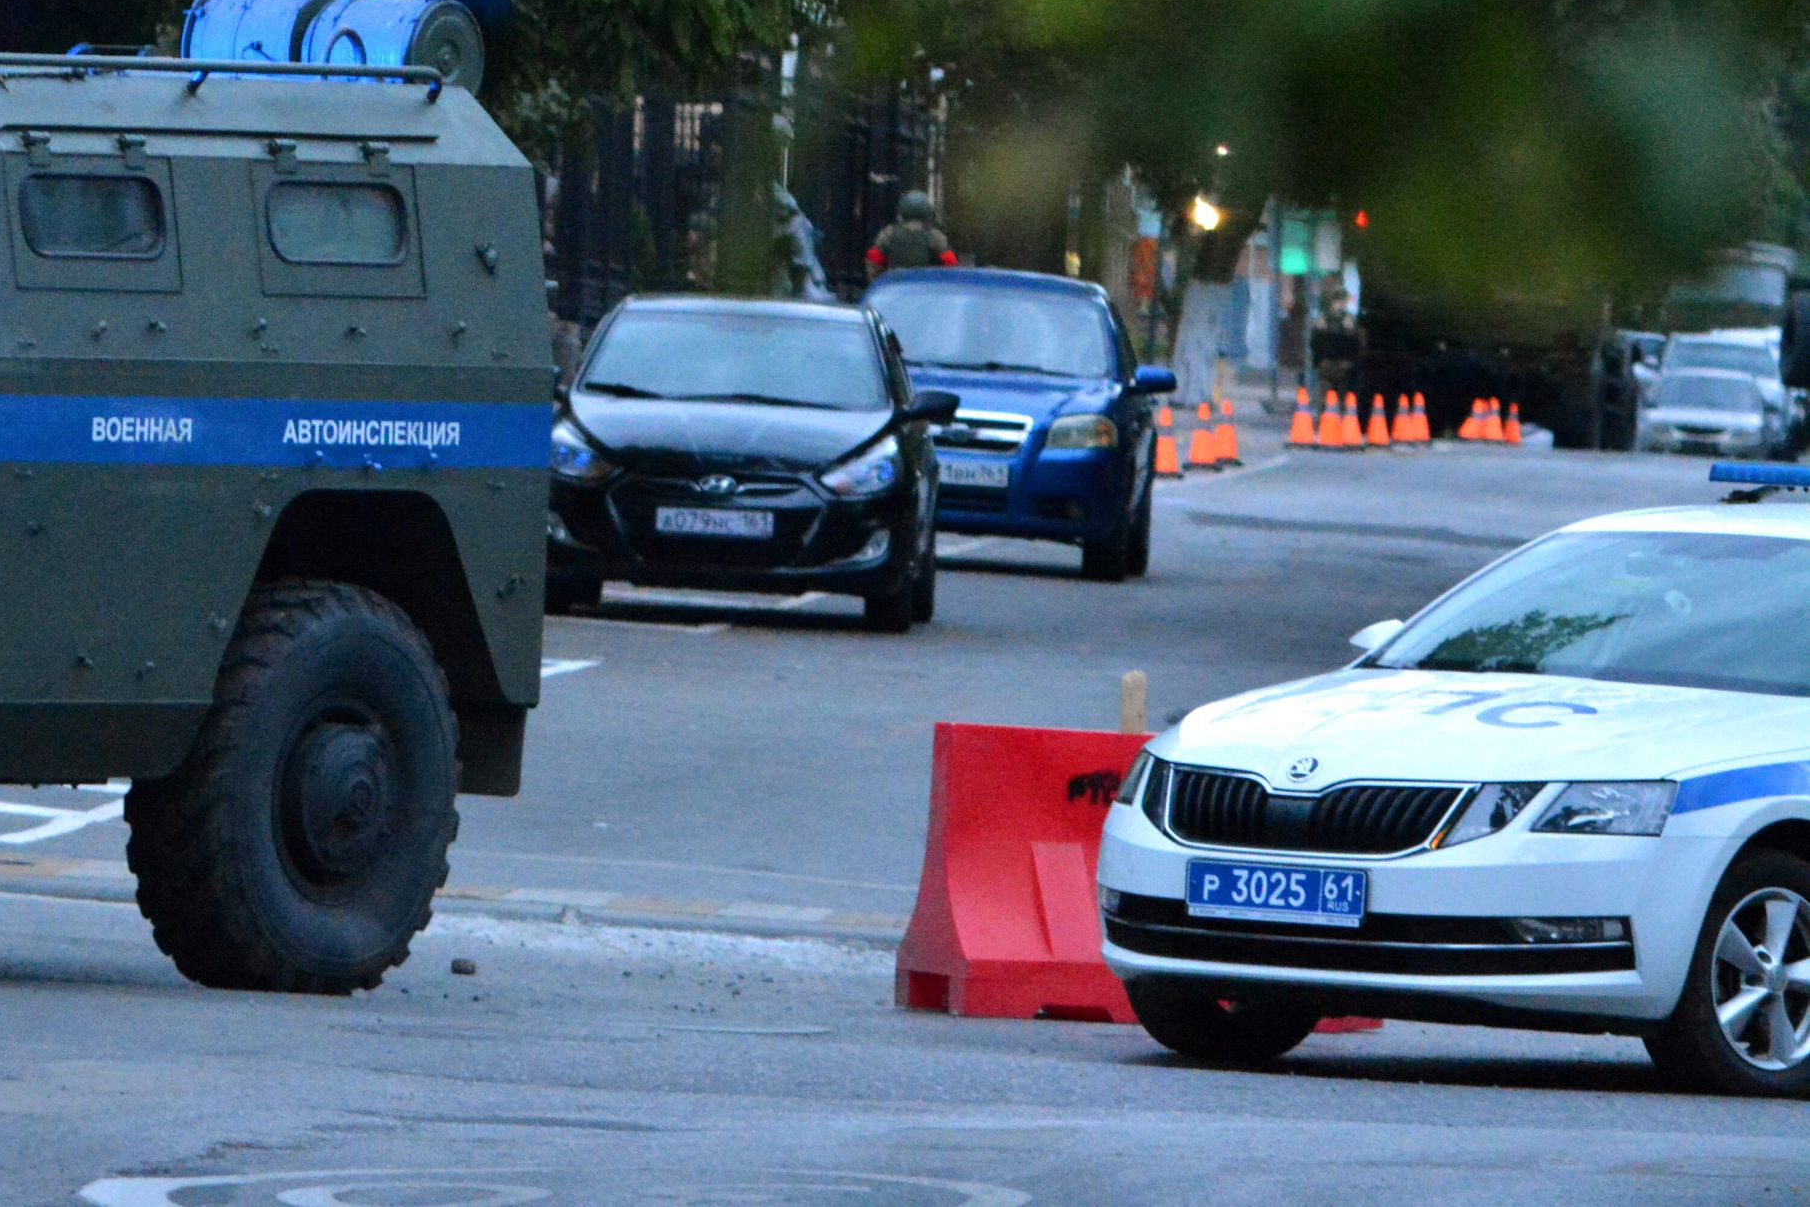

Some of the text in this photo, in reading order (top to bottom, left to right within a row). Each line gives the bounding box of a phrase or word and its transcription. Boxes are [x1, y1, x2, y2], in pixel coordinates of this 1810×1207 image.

[92, 417, 460, 450] ВОЕННАЯ АВТОИНСПЕКЦИЯ
[1231, 869, 1307, 907] 3025
[1323, 874, 1354, 902] 61
[1327, 901, 1350, 912] RUS
